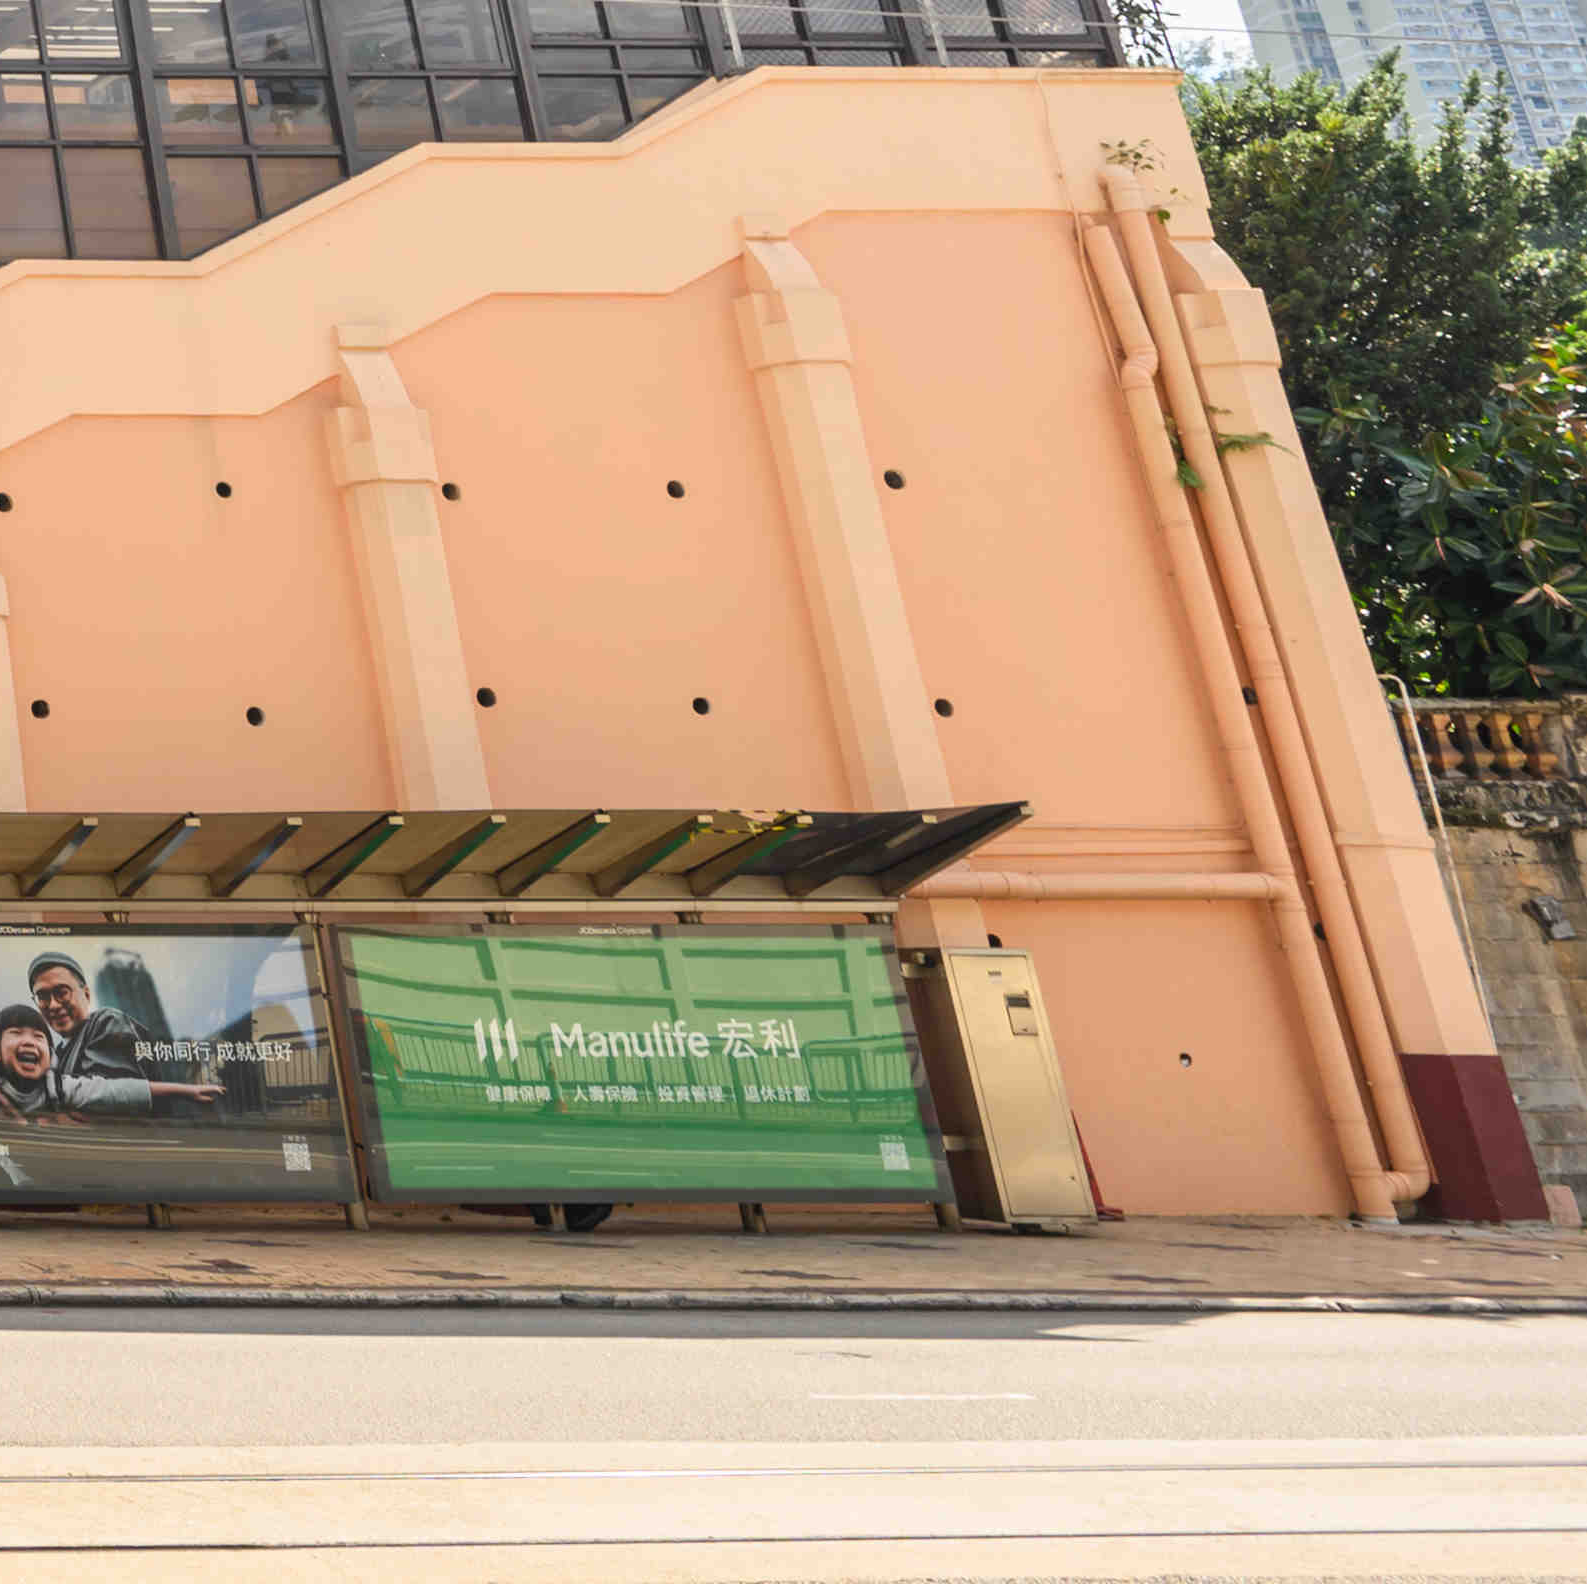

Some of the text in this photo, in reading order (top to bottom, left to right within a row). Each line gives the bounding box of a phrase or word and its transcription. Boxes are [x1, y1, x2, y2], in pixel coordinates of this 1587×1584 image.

[134, 1041, 294, 1062] 與你同行 成就更好
[550, 1018, 801, 1059] Manulife 宏利
